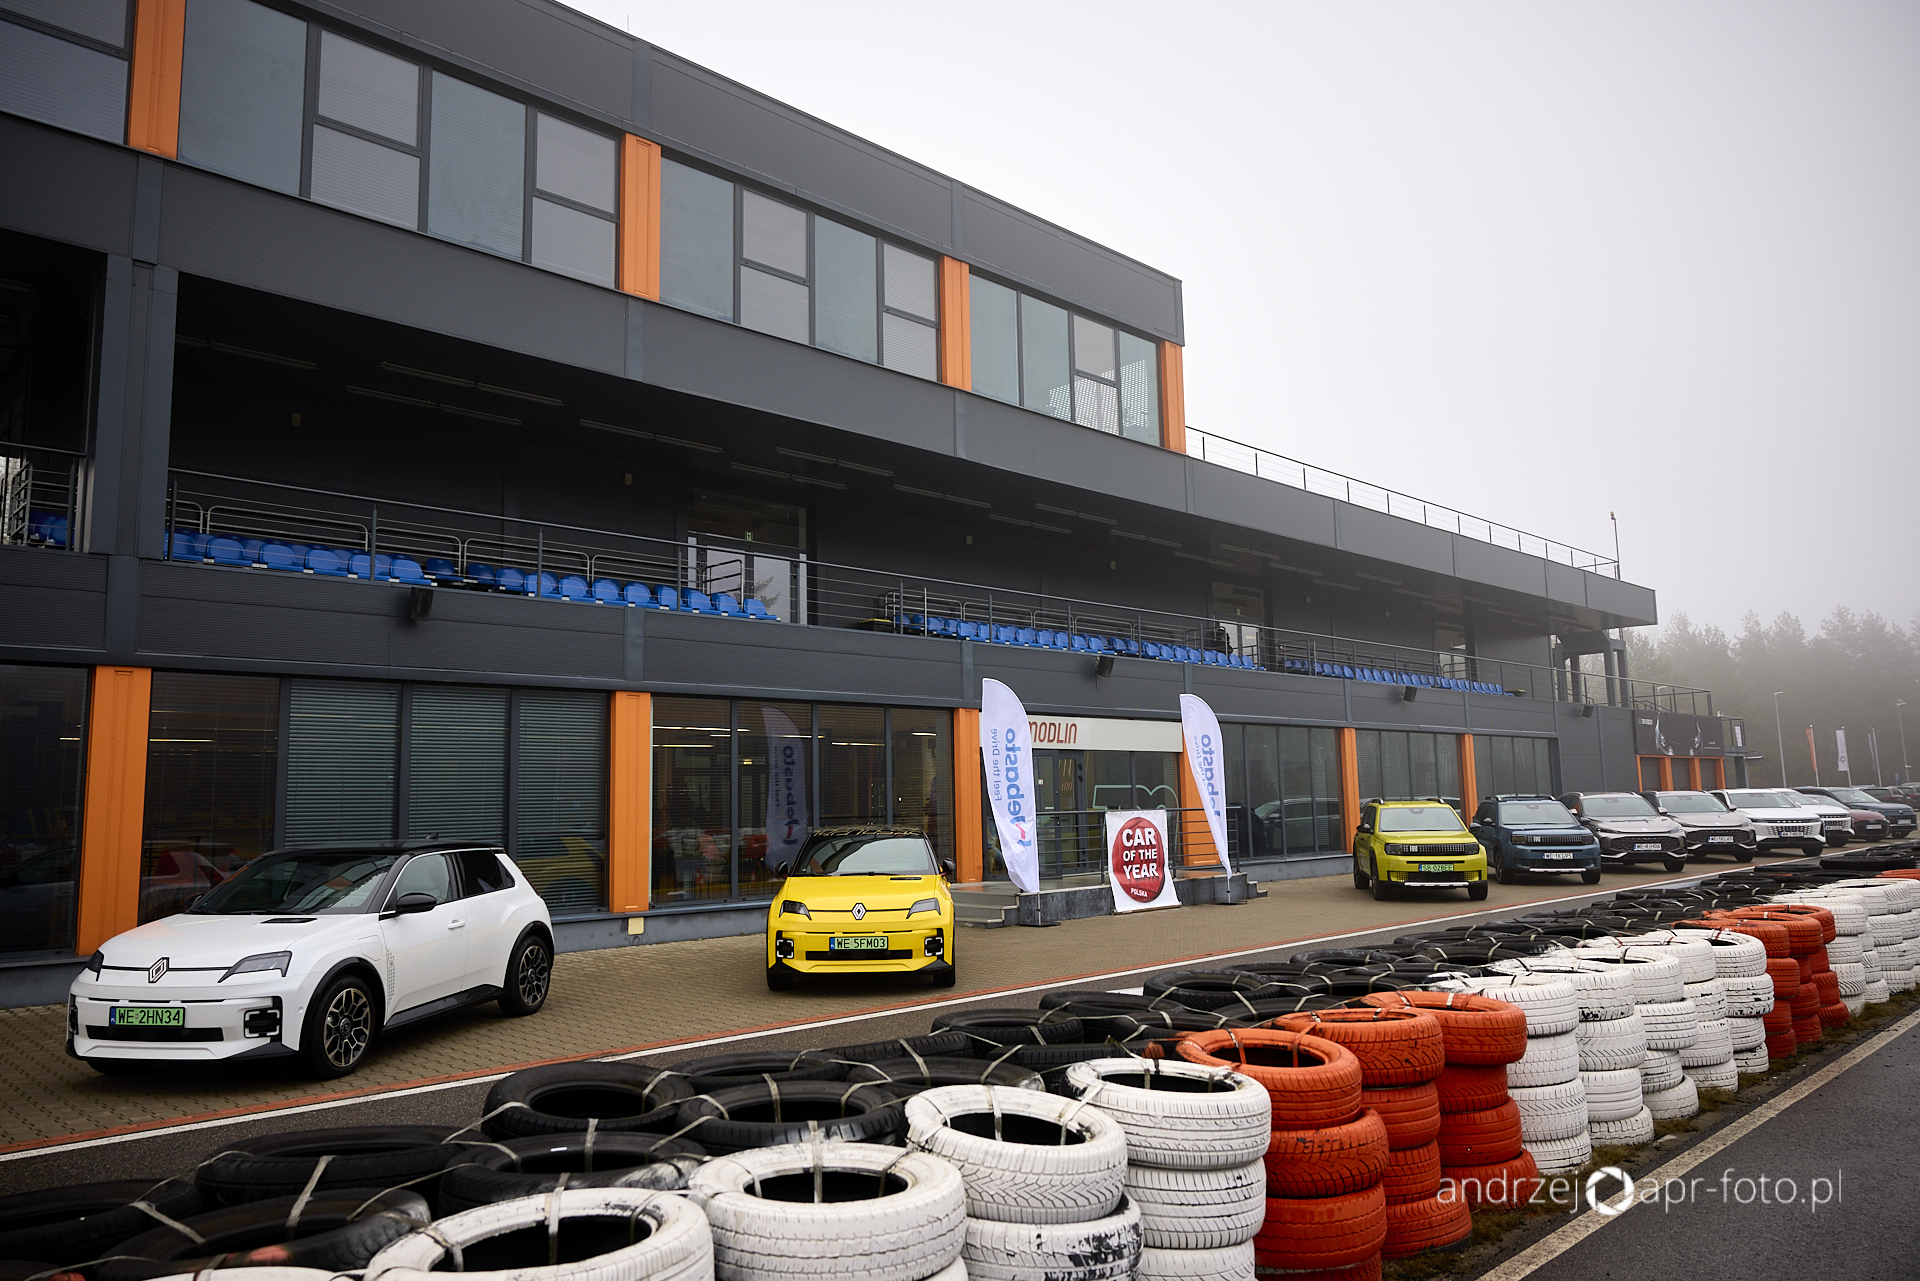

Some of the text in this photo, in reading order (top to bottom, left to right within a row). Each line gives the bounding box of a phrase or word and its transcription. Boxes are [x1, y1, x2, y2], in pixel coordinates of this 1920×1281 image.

[1122, 828, 1156, 847] CAR
[1123, 848, 1157, 862] OF THE
[1123, 862, 1159, 880] YEAR
[1130, 887, 1148, 898] POLSKA
[836, 938, 850, 948] WE
[854, 938, 885, 948] 5FM03
[118, 1009, 134, 1023] WE
[138, 1010, 180, 1024] 2HN34
